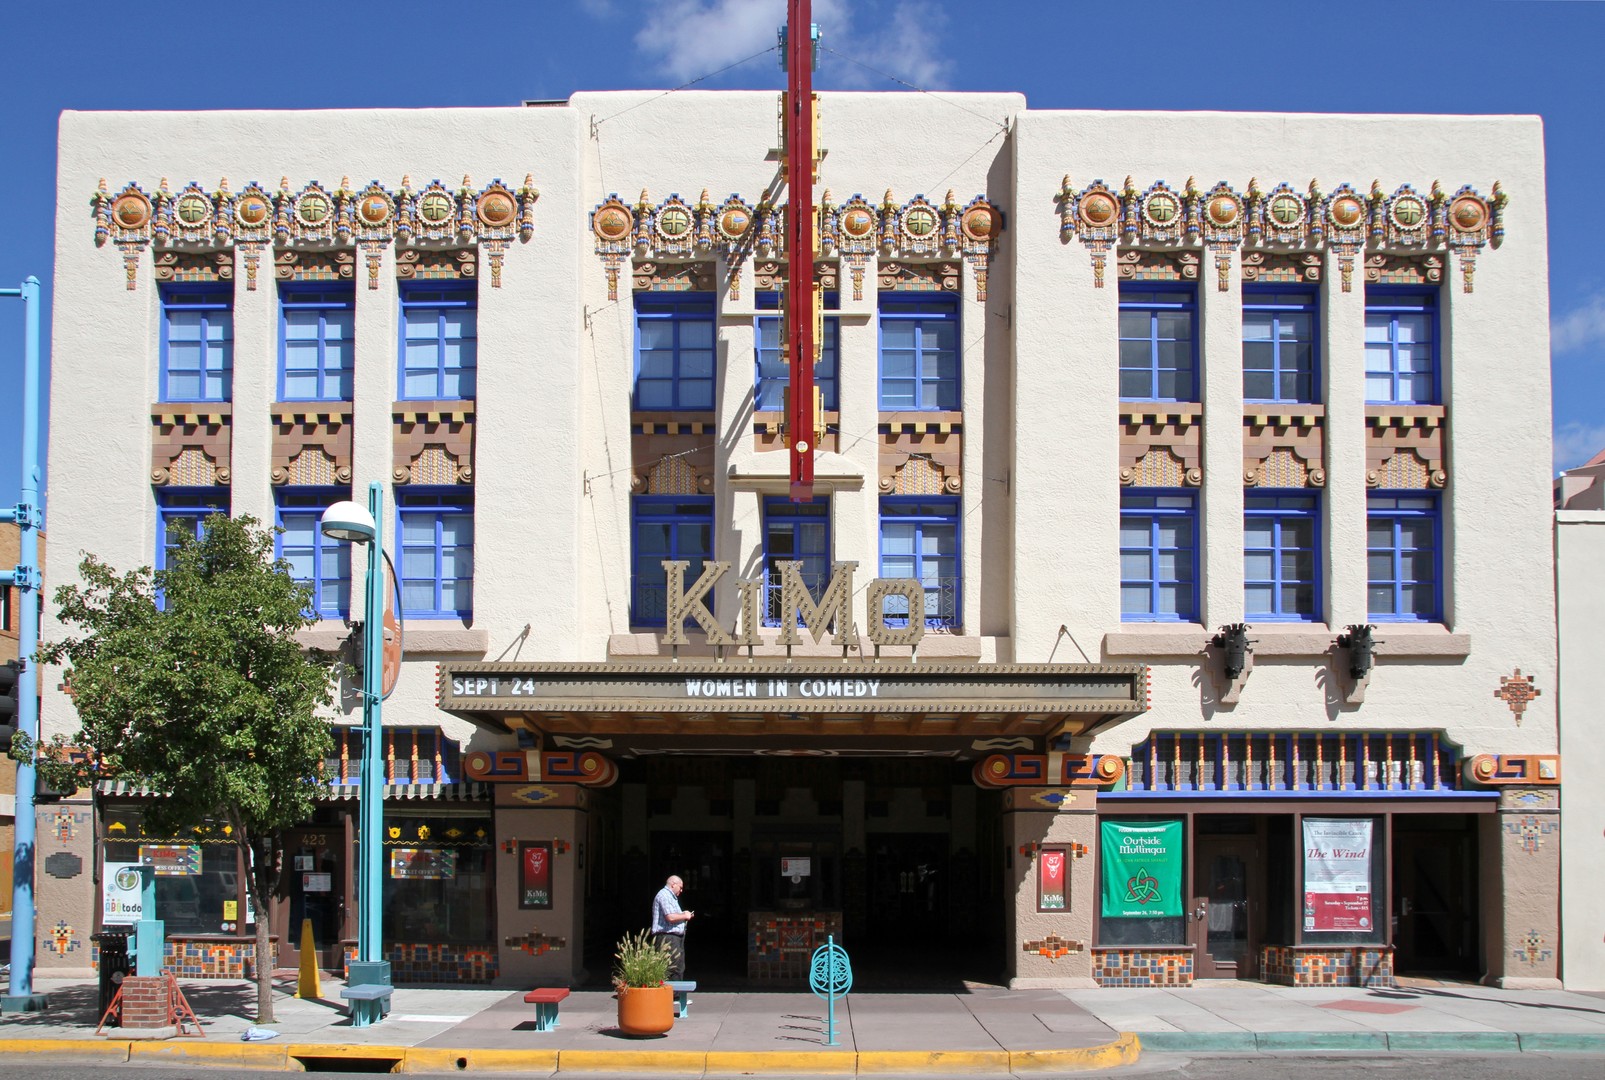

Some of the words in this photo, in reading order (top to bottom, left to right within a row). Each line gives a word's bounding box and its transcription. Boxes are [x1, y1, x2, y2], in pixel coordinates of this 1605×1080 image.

[453, 678, 499, 695] SEPT
[511, 677, 535, 695] 24
[685, 679, 757, 697] WOMEN
[768, 679, 788, 697] IN
[799, 679, 880, 697] COMEDY
[302, 834, 326, 845] 423
[1123, 836, 1162, 846] Outside
[1119, 846, 1166, 855] Mullingar
[1308, 848, 1327, 858] The
[1332, 848, 1366, 858] Wind
[1048, 857, 1059, 865] 87
